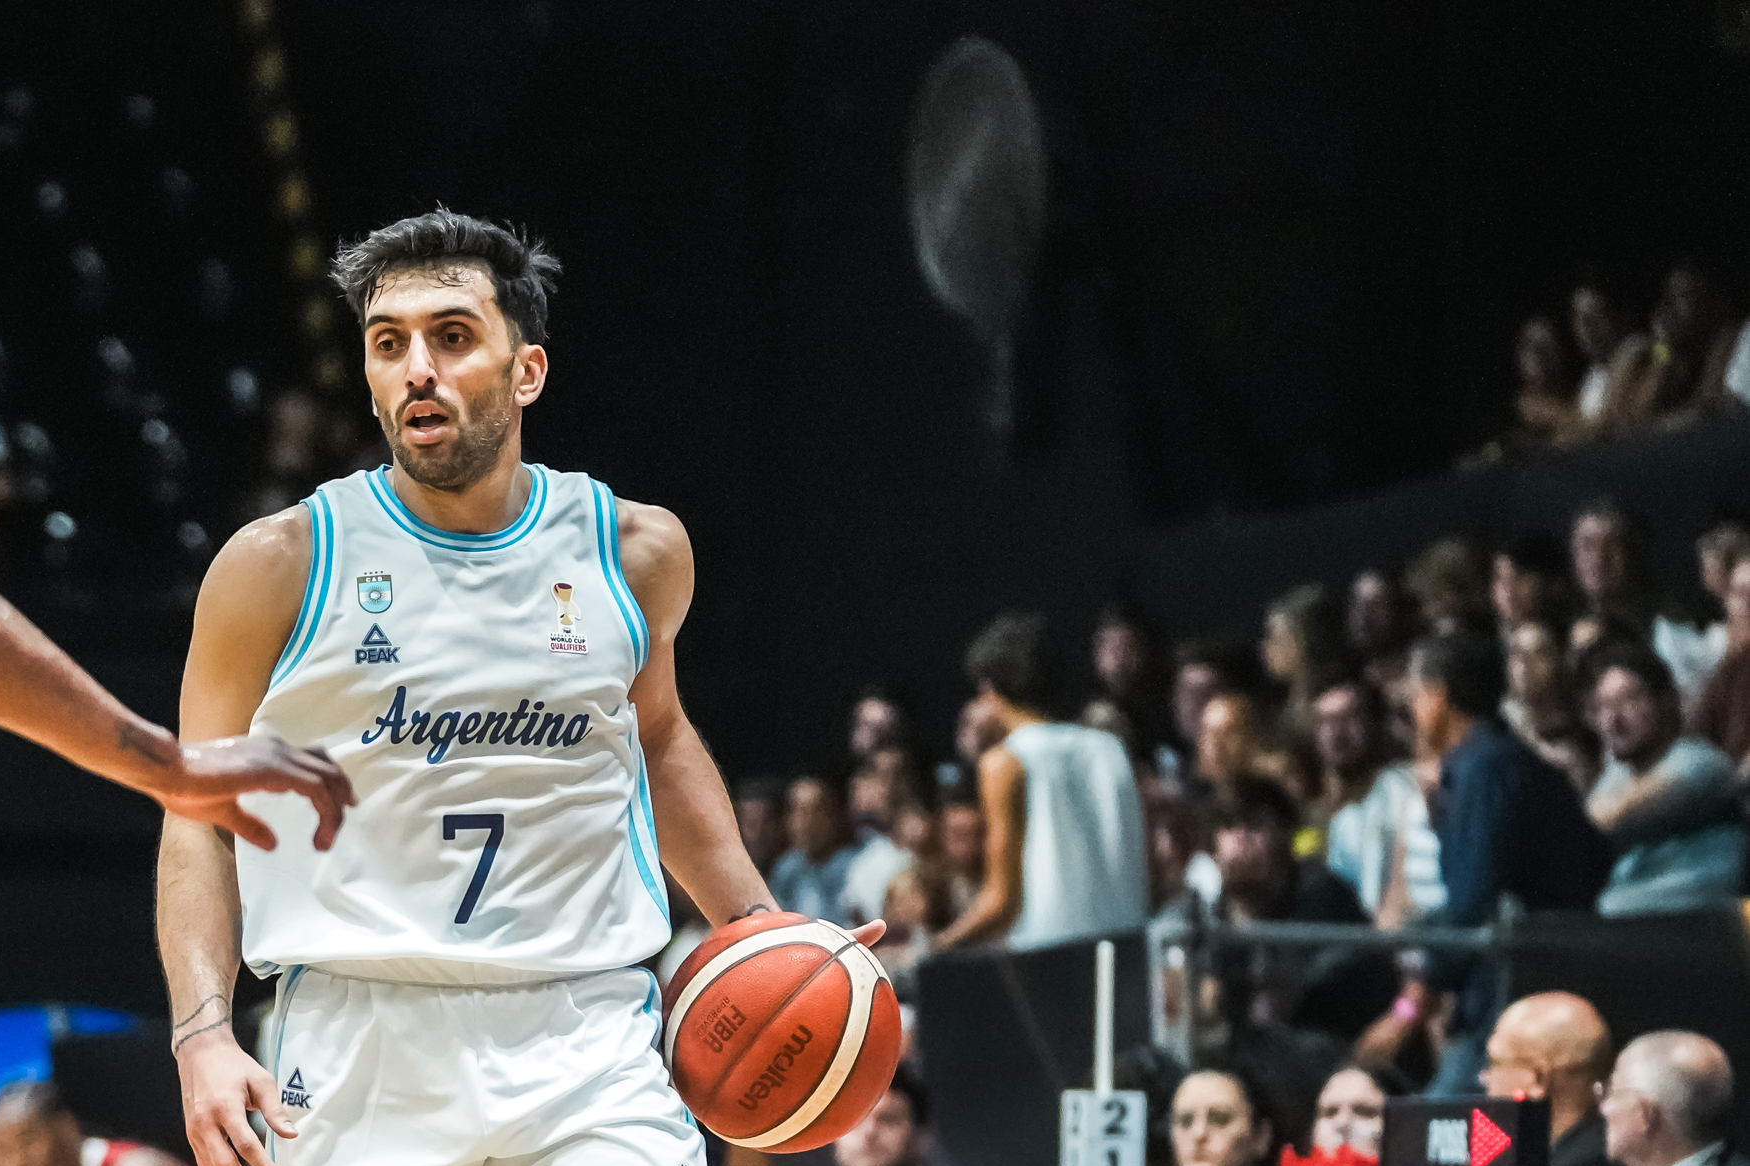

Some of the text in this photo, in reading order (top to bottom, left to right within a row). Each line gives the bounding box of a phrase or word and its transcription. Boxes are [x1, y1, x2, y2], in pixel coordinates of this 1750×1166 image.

[355, 647, 401, 665] PEAK
[550, 643, 587, 652] QUALIFIERS
[361, 685, 593, 765] Argentina
[443, 813, 505, 924] 7
[704, 1004, 748, 1054] FIBA
[737, 1024, 813, 1111] molten
[281, 1089, 313, 1109] PEAK
[1102, 1099, 1129, 1136] 2
